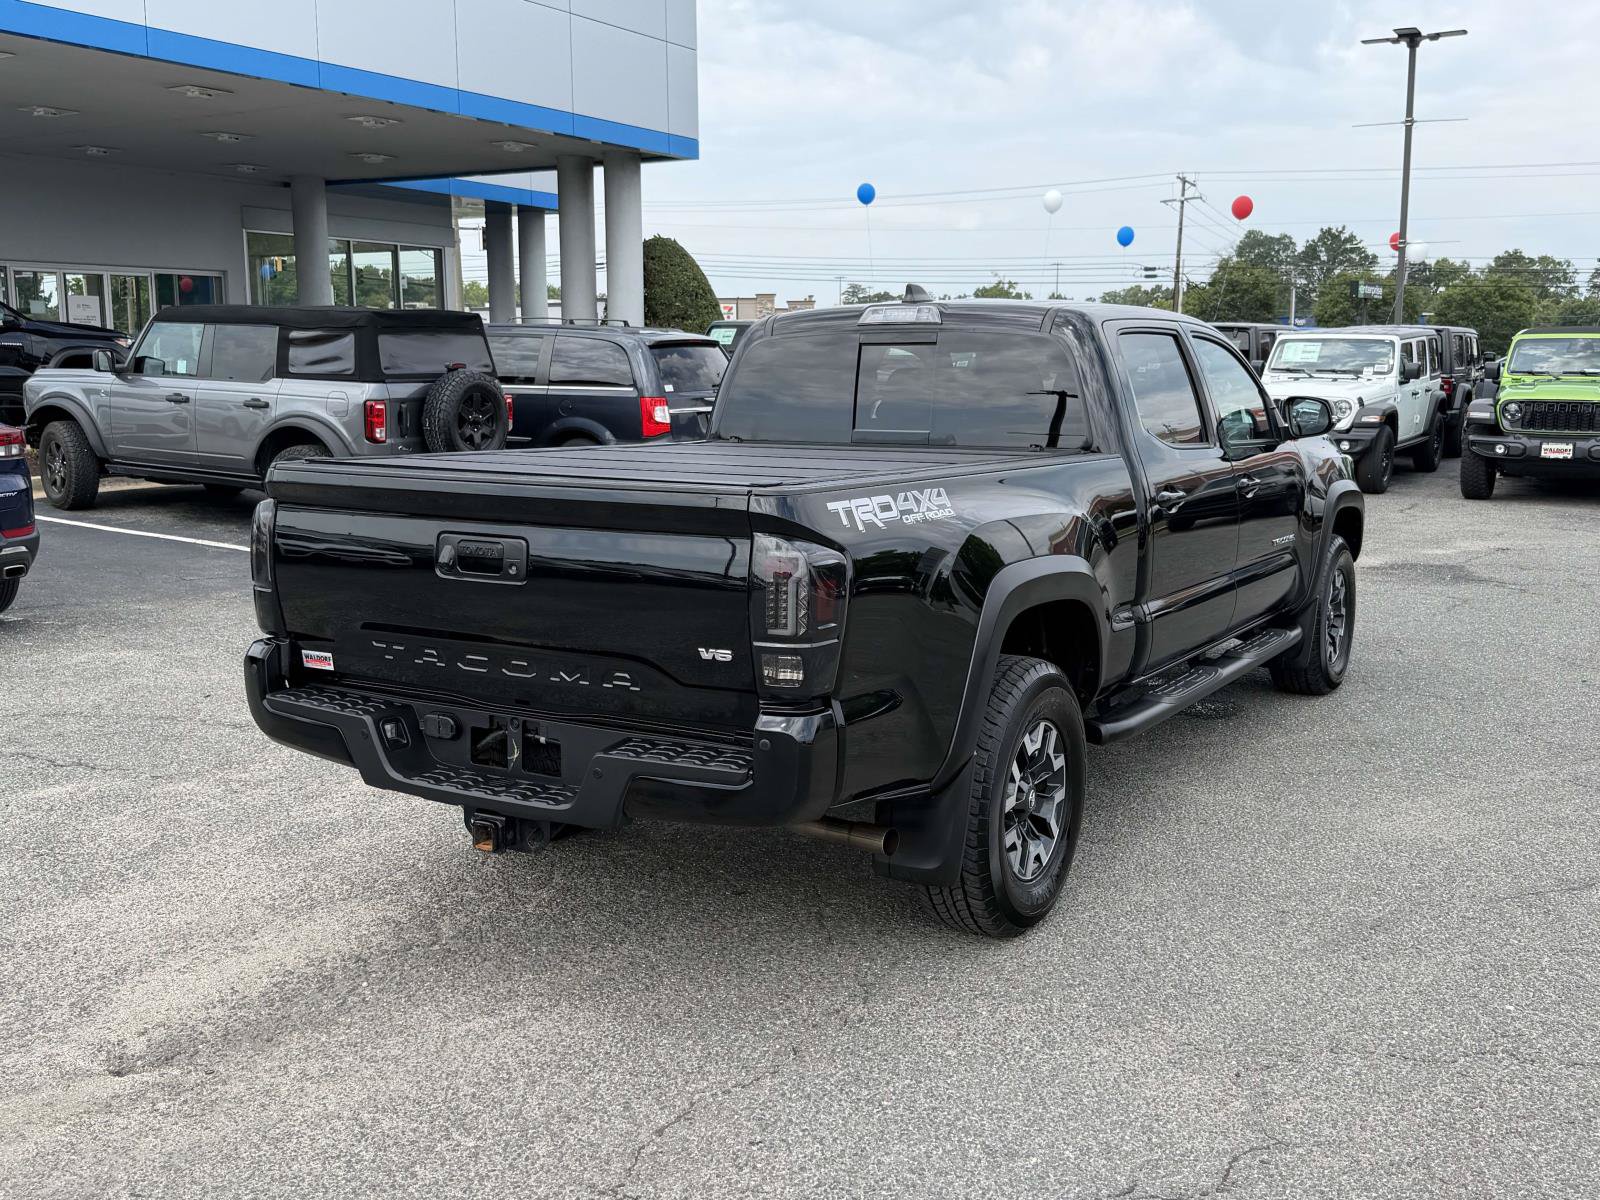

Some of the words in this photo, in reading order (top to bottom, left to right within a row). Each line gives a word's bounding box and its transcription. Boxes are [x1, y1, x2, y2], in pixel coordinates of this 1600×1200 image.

[826, 494, 900, 532] TRD
[902, 512, 926, 525] OFF
[924, 508, 957, 521] ROAD
[462, 543, 499, 558] TOYOTA
[304, 652, 332, 663] WALDORF
[697, 647, 733, 662] V6
[371, 640, 642, 691] TACOMA
